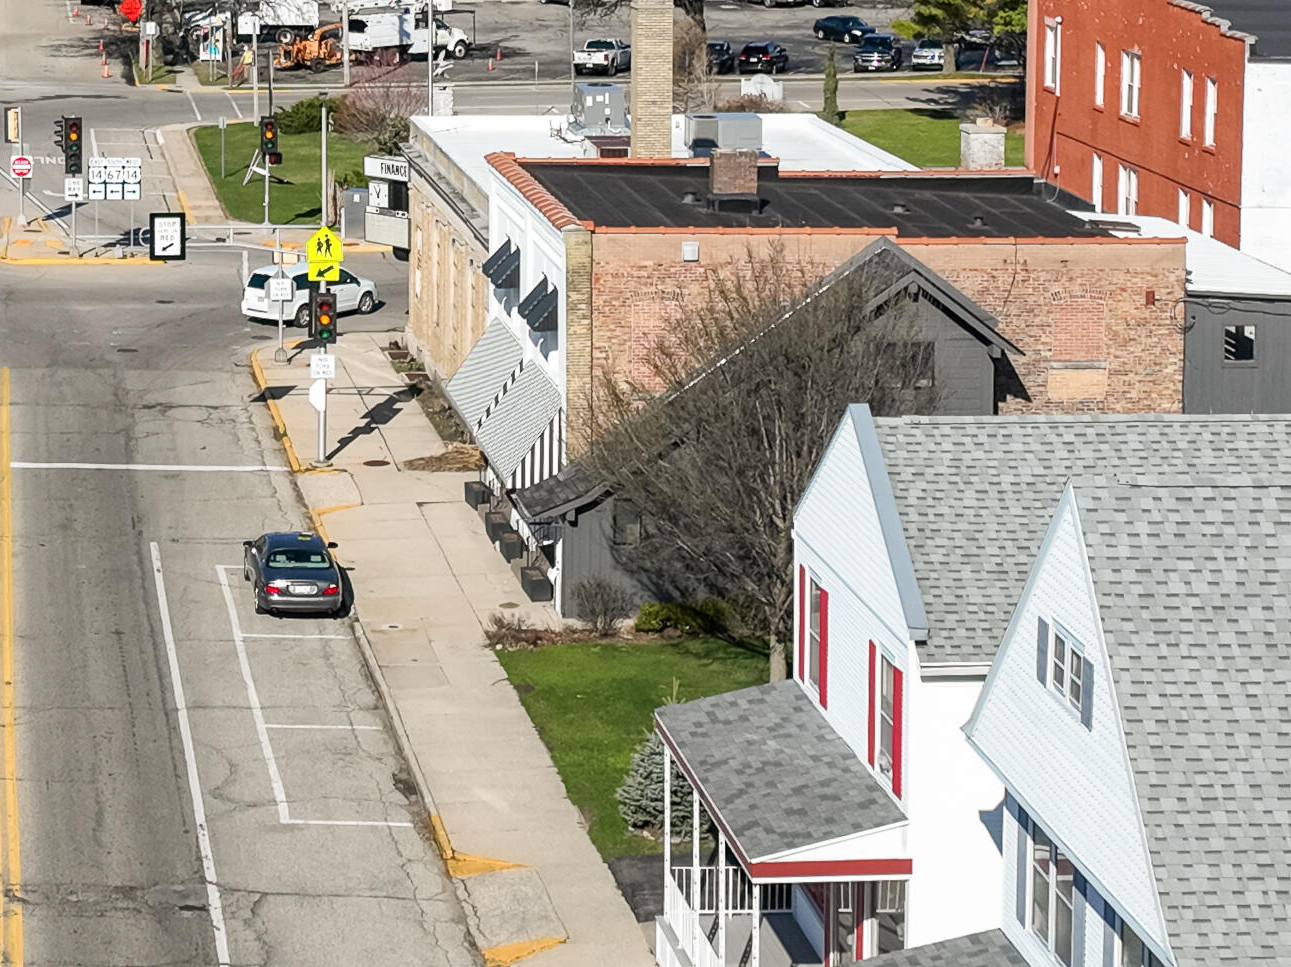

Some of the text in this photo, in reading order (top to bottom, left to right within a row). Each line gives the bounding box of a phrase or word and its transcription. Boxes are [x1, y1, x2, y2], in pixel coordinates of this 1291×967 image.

[91, 170, 102, 180] 14
[107, 170, 121, 180] 67
[126, 170, 137, 180] 14
